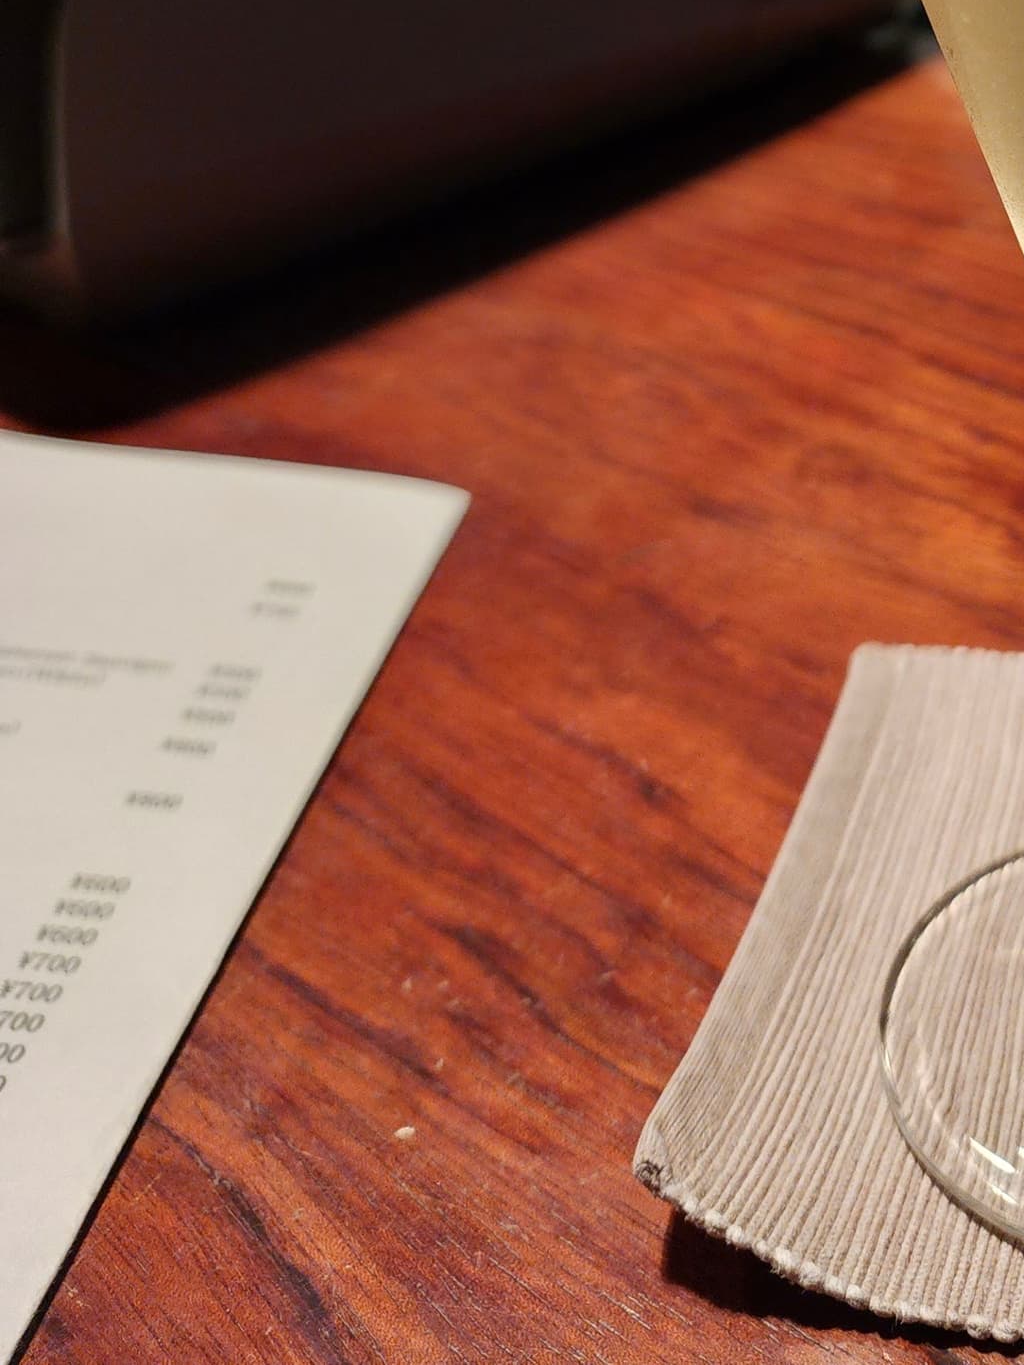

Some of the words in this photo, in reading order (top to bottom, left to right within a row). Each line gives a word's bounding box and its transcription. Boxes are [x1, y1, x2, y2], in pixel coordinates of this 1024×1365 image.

[37, 924, 99, 946] ¥600
[18, 951, 82, 974] ¥700
[0, 979, 63, 1003] ¥700
